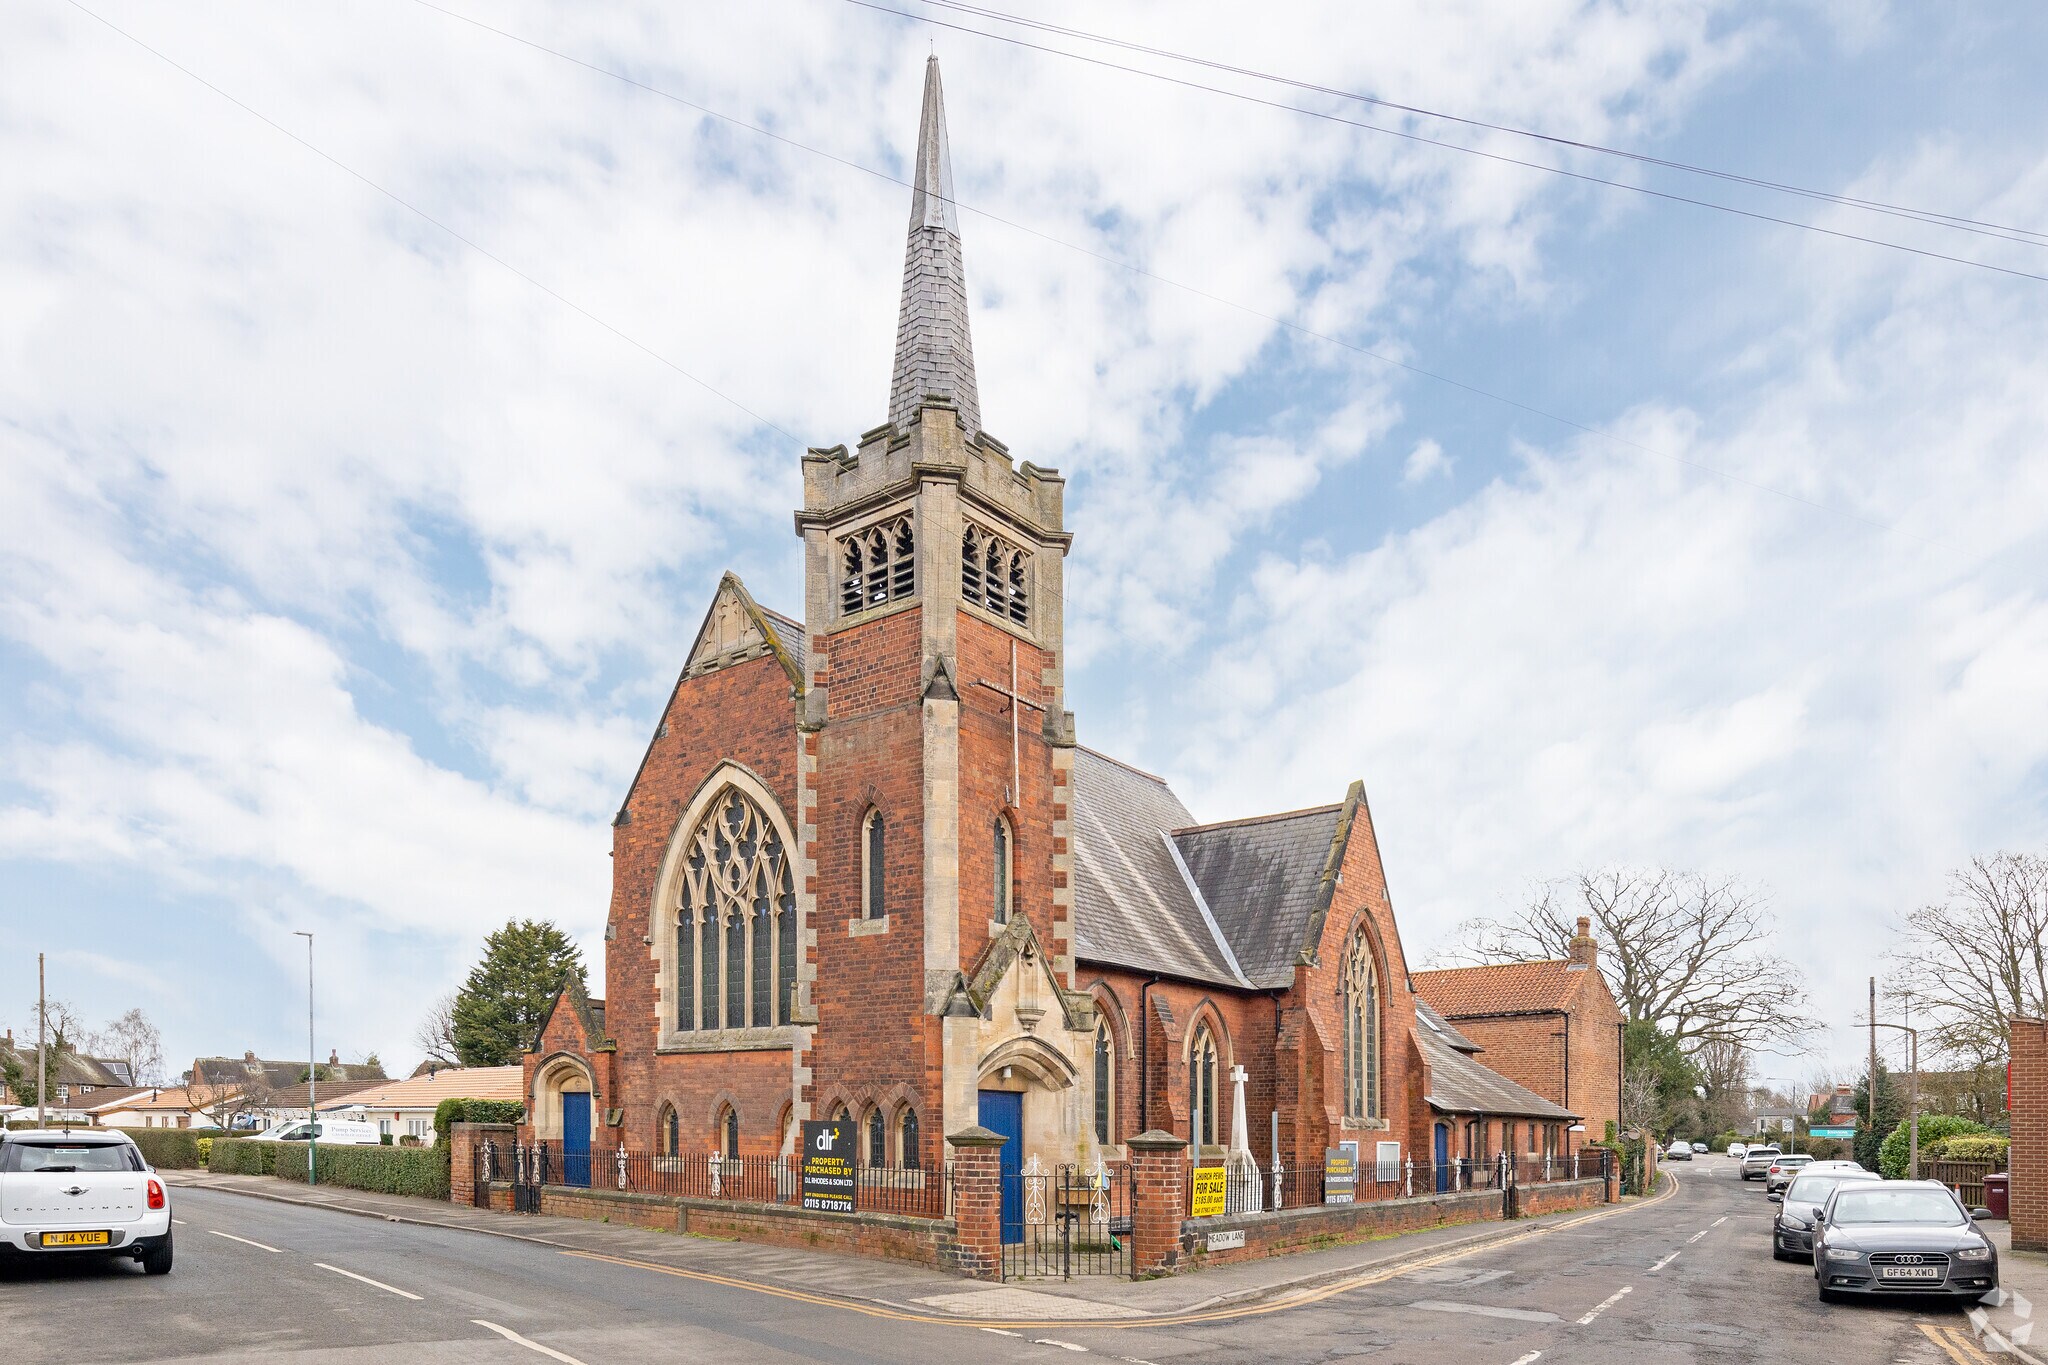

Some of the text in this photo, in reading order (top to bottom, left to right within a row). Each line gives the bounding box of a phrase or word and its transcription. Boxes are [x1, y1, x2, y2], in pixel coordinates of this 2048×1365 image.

[811, 1157, 845, 1166] PROPERTY
[804, 1165, 853, 1176] PURCHASED BY
[811, 1177, 828, 1185] RHODES
[844, 1179, 853, 1187] LTD
[1195, 1173, 1212, 1181] CHURCH
[1195, 1181, 1224, 1194] FOR SALE
[804, 1198, 852, 1211] 0115 8718714
[50, 1233, 101, 1243] NJ14 YUE
[1208, 1230, 1243, 1243] MEADOW LANE
[1887, 1268, 1934, 1277] GF64 XWO
